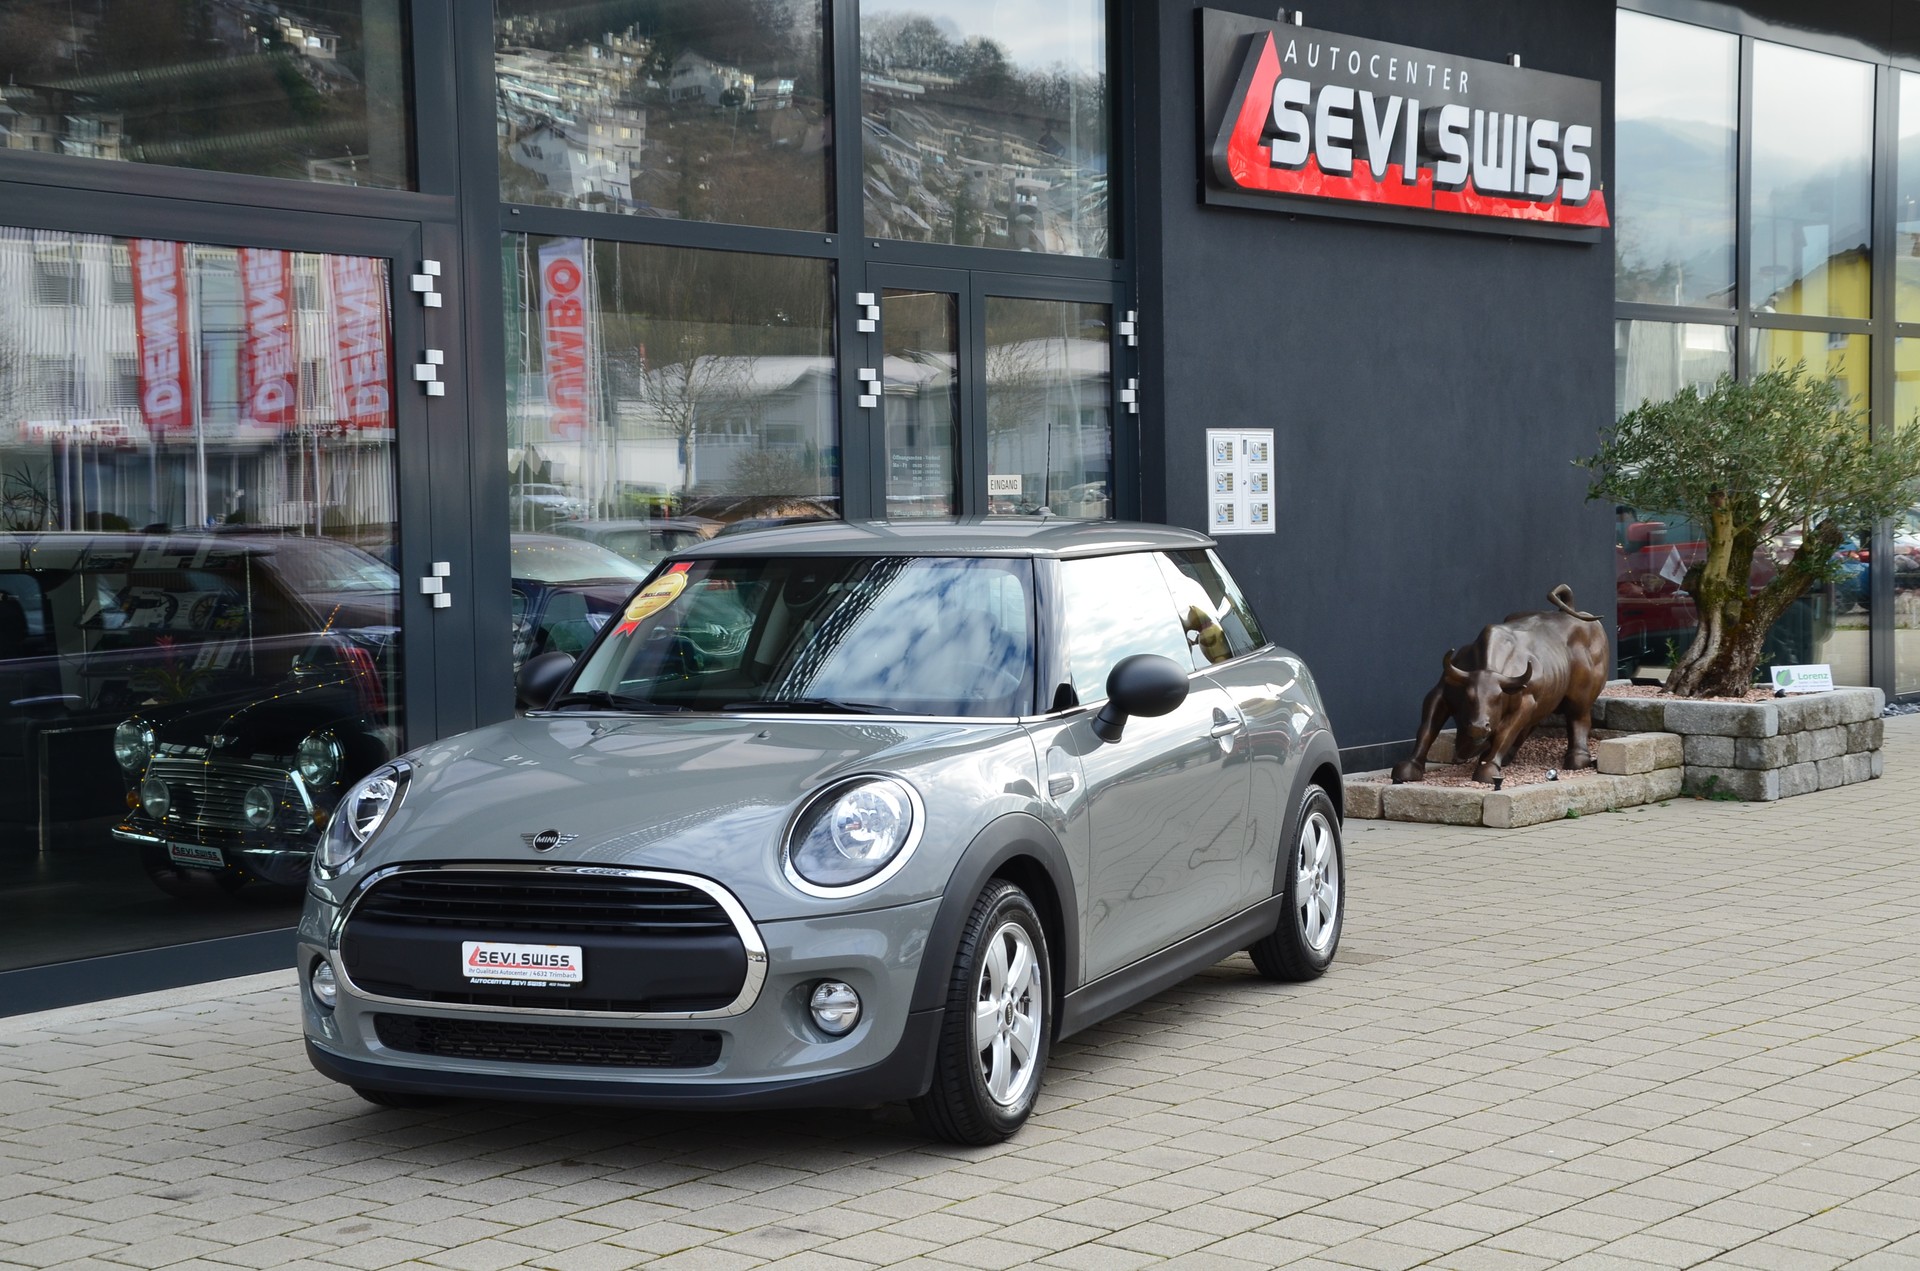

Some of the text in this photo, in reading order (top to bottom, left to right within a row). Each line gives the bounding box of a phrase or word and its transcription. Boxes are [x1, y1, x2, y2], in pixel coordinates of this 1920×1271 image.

[1284, 39, 1469, 94] AUTOCENTER
[1271, 77, 1592, 201] SEVI SWISS
[990, 479, 1018, 490] EINGANG
[175, 847, 218, 859] SEVI SWISS
[478, 951, 570, 967] SEVI SWISS
[500, 969, 528, 977] Autocenter
[549, 971, 577, 979] Trimbach
